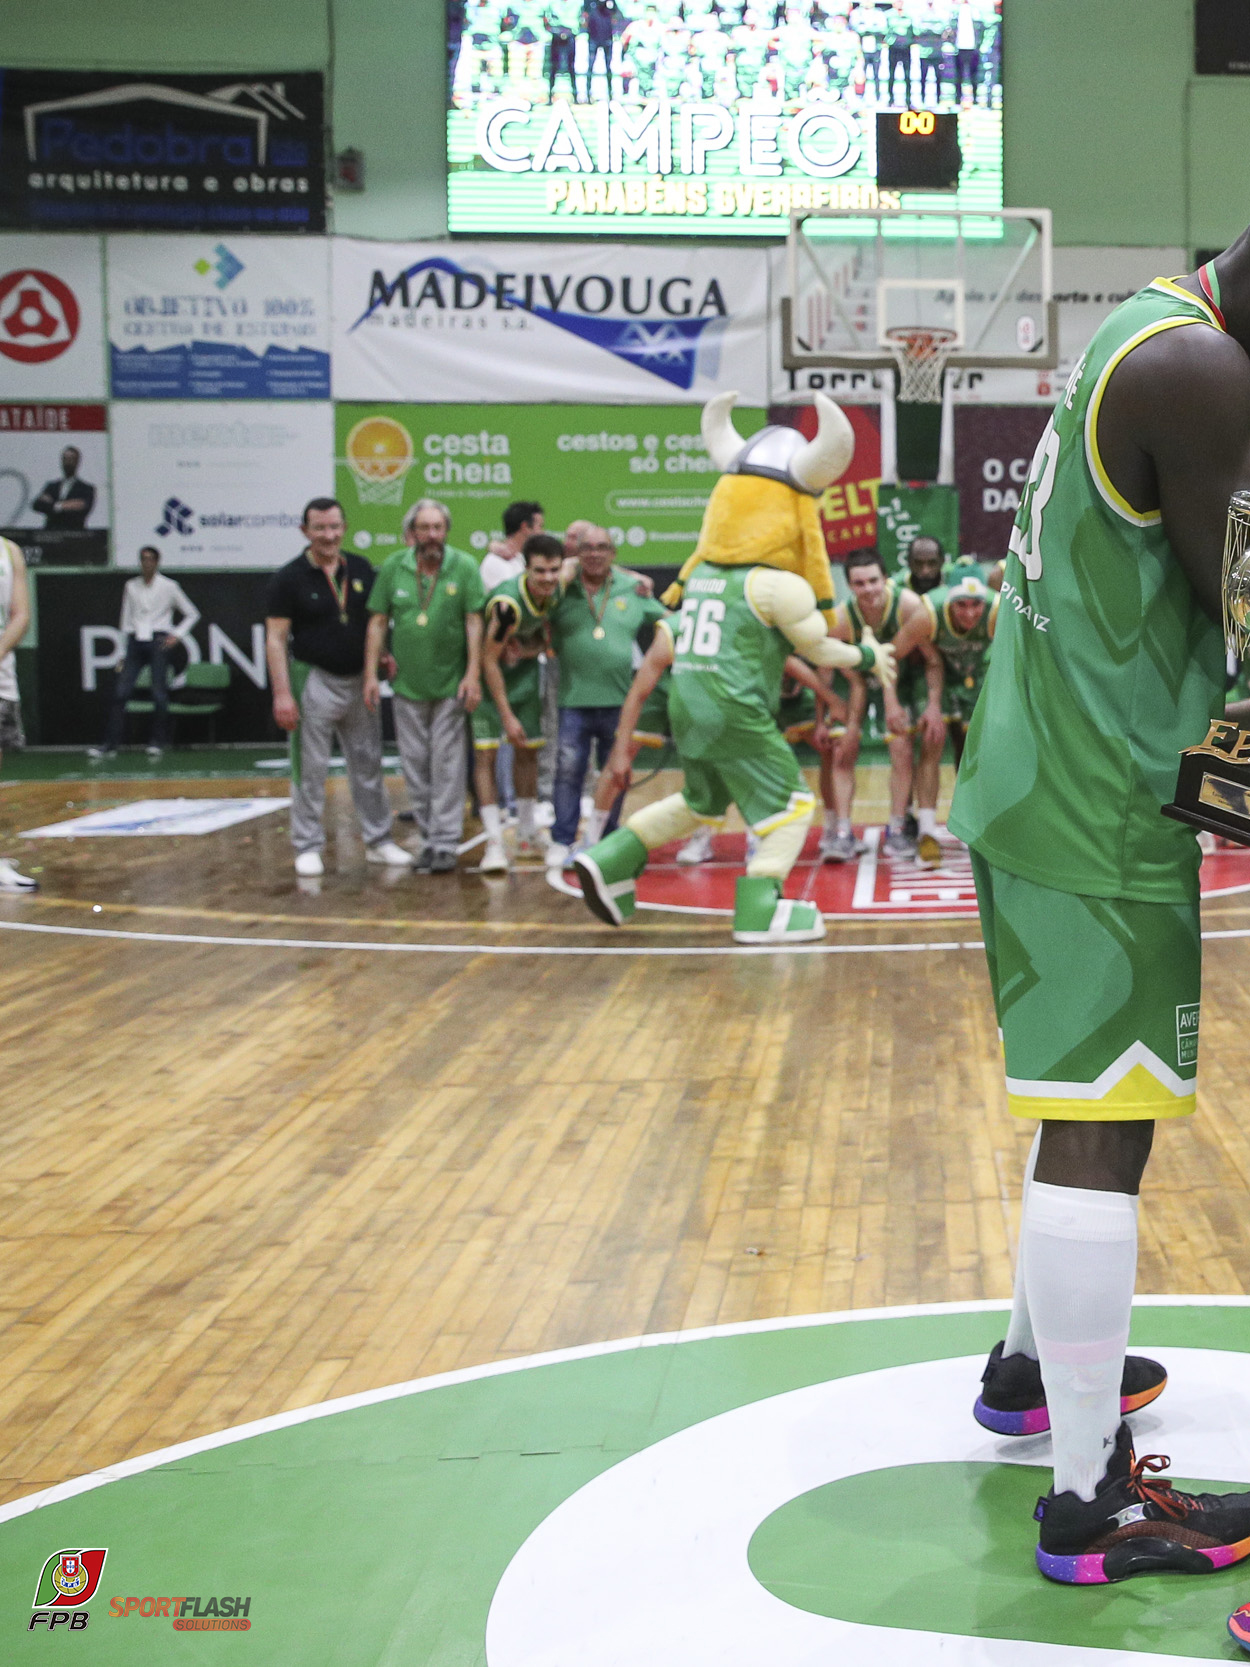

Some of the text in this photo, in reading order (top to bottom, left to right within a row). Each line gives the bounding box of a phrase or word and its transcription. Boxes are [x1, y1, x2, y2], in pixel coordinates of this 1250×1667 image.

[28, 170, 309, 193] arquitetura e obras
[368, 269, 728, 317] MADEIVOUGA
[423, 430, 510, 456] cesta
[557, 431, 639, 451] cestos
[643, 434, 659, 452] e
[423, 455, 513, 484] cheia
[629, 452, 660, 474] só
[982, 460, 1005, 482] O
[675, 597, 726, 657] 56
